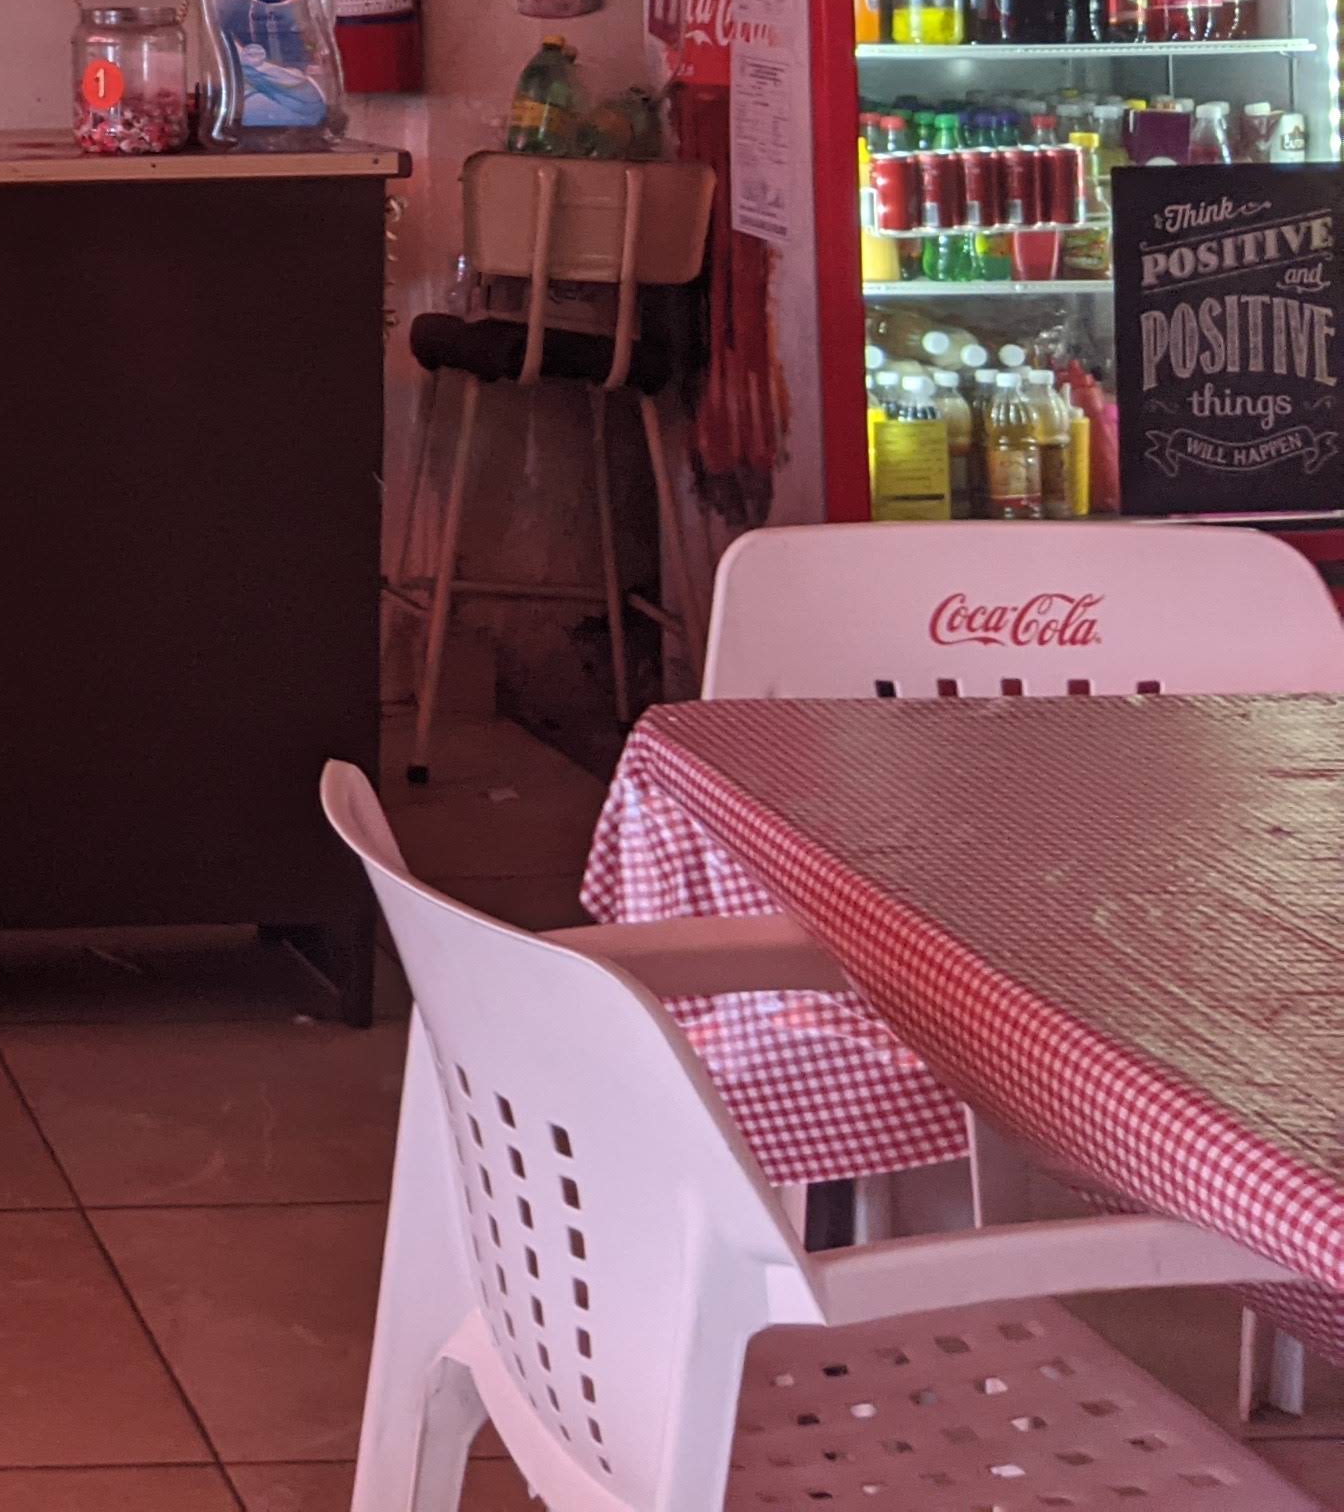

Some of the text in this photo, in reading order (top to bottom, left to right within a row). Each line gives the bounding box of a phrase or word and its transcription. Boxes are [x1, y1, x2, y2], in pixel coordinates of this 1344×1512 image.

[95, 67, 105, 98] 1
[1164, 196, 1234, 233] Think
[1141, 216, 1334, 287] POSITIVE
[1284, 263, 1324, 285] and
[1140, 295, 1337, 392] POSITIVE
[1187, 382, 1292, 430] things
[1187, 433, 1303, 466] WILL HAPPEN
[929, 592, 1105, 647] Coca-Cola
